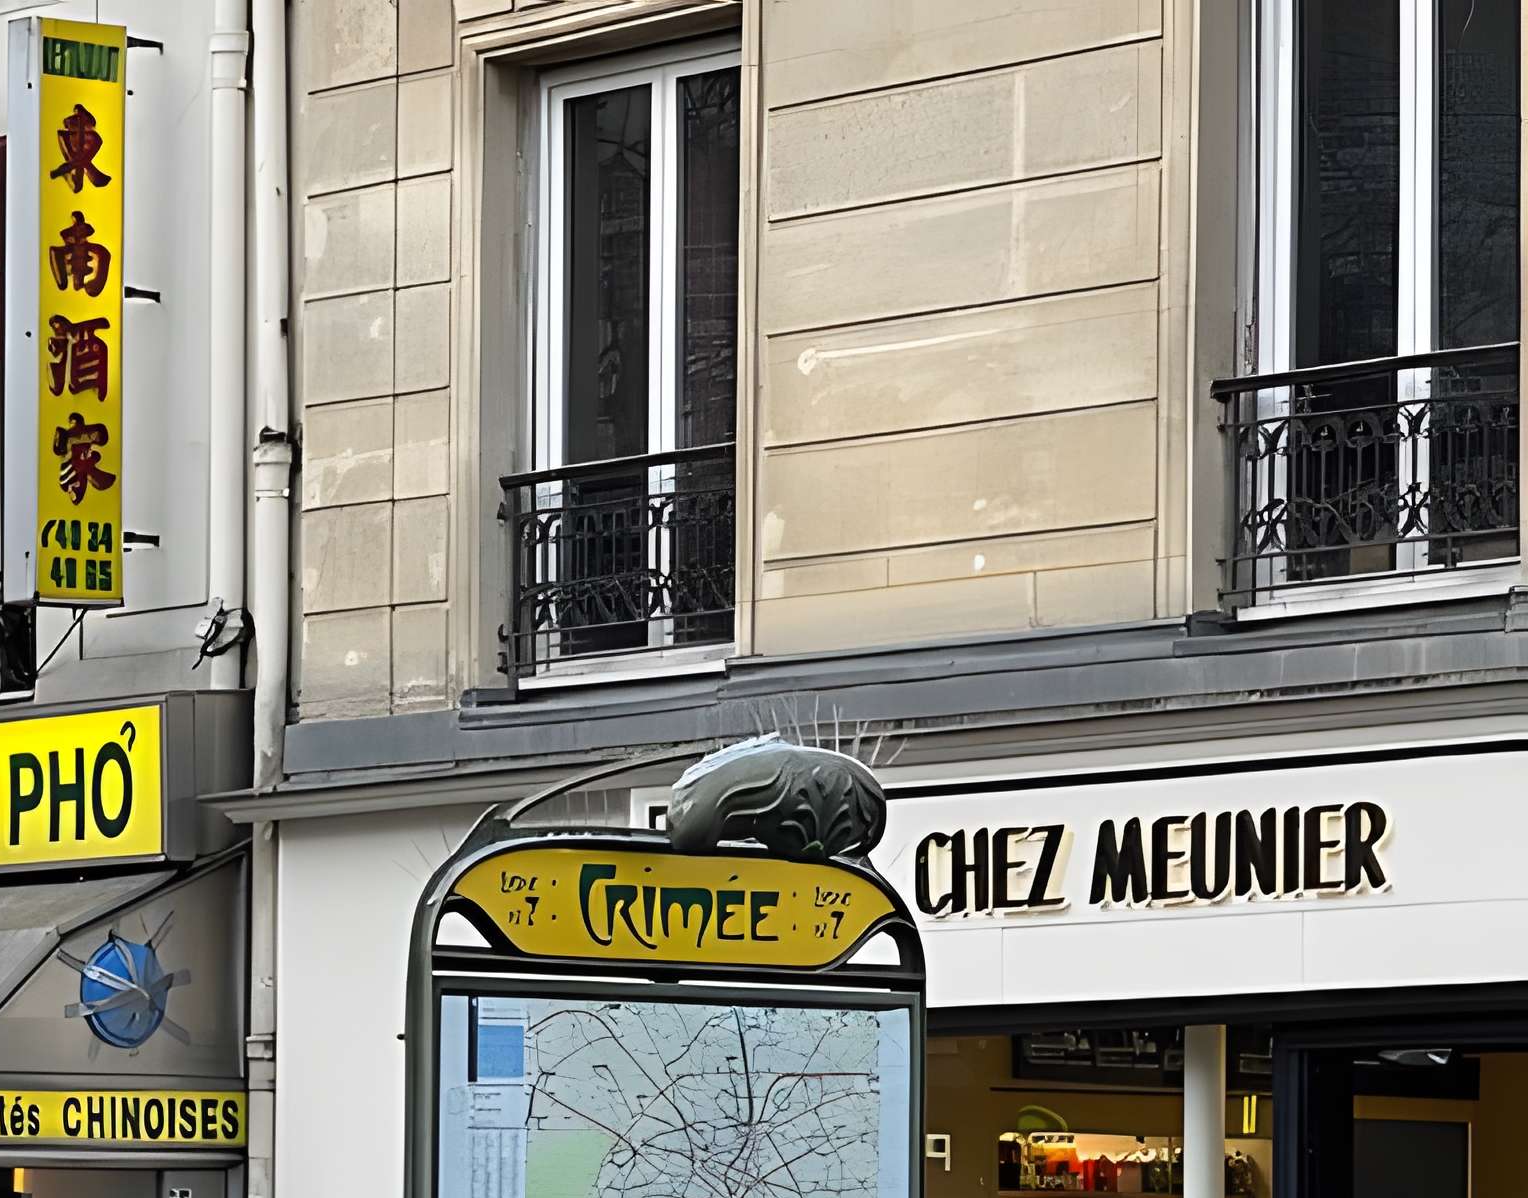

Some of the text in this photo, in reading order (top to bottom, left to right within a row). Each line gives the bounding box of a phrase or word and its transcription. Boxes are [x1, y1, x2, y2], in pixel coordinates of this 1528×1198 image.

[47, 103, 117, 505] 東南酒家
[579, 863, 780, 951] CRIMÉE
[915, 801, 1389, 914] CHEZ MEUNIER
[63, 1096, 240, 1140] CHINOISES
